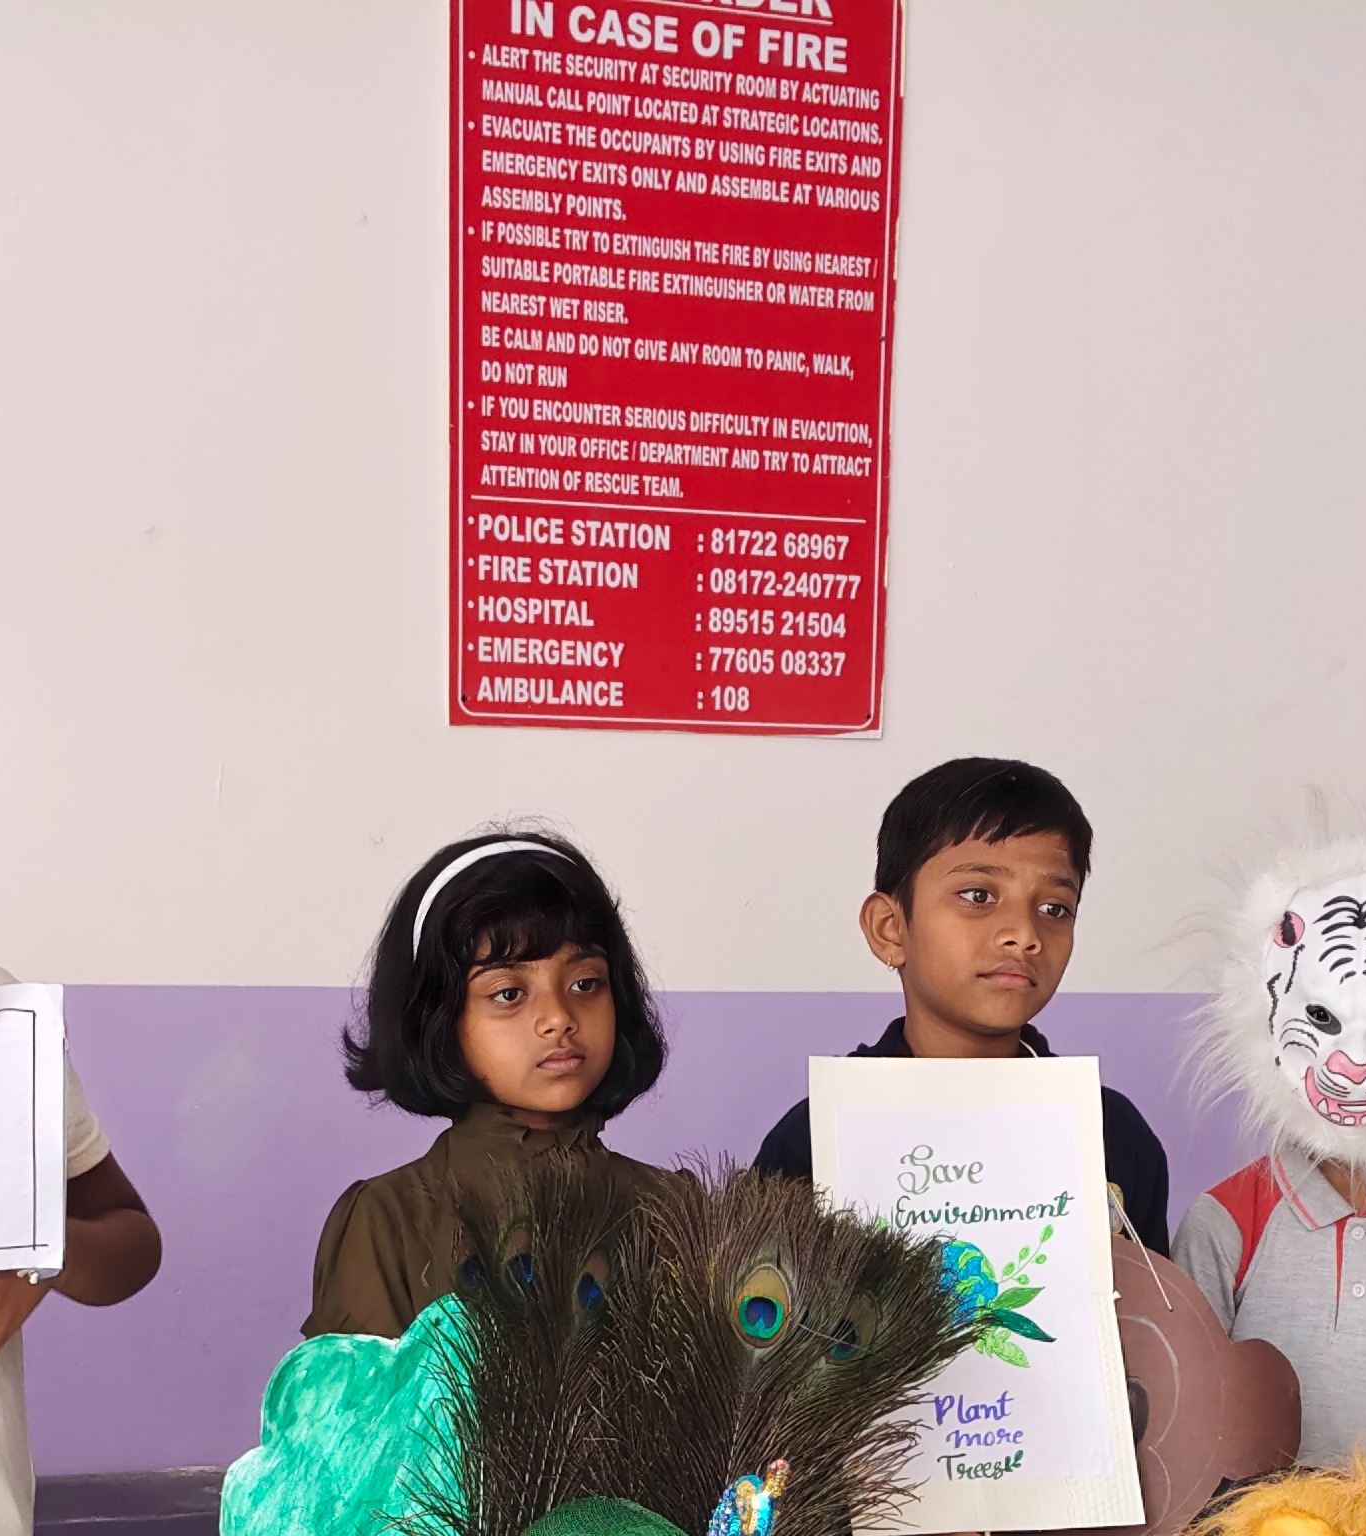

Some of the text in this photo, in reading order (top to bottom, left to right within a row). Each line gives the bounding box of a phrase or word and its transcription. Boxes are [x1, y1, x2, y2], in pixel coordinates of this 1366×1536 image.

[510, 1, 553, 38] IN
[568, 5, 678, 53] CASE
[692, 19, 745, 61] OF
[758, 28, 847, 73] FIRE
[482, 43, 879, 110] ALERT THE SECURITY AT SECURITY ROOM BY ACTUATING
[482, 79, 883, 145] MANUAL CALL POINT LOCATED AT STRATEGIC LOCATIONS.
[482, 114, 881, 178] EVACUATE THE OCCUPANTS BY USING FIRE EXITS AND
[482, 149, 879, 212] EMERGENCY EXITS ONLY AND ASSEMBLE AT VARIOUS
[481, 185, 626, 221] ASSEMBLY POINTS.
[481, 220, 494, 242] IF
[497, 221, 560, 249] POSSIBLE
[563, 228, 589, 251] TRY
[592, 231, 609, 253] TO
[612, 233, 691, 261] EXTINGUISH
[693, 241, 719, 264] THE
[721, 243, 750, 267] FIRE
[752, 246, 770, 268] BY
[773, 249, 811, 273] USING
[814, 252, 871, 278] NEAREST
[481, 255, 874, 311] SUITABLE PORTABLE FIRE EXTINGUISHER OR WATER FROM
[481, 290, 628, 324] NEAREST WET RISER.
[481, 325, 853, 379] BE CALM AND DO NOT GIVE ANY ROOM TO PANIC, WALK,
[481, 359, 567, 388] DO NOT RUN
[481, 395, 872, 447] IF YOU ENCOUNTER SERIOUS DIFFICULTY IN EVACUTION,
[480, 430, 515, 453] STAY
[519, 432, 534, 454] IN
[538, 434, 577, 457] YOUR
[579, 437, 629, 461] OFFICE
[639, 441, 729, 468] DEPARTMENT
[730, 448, 759, 470] AND
[762, 450, 789, 471] TRY
[791, 452, 809, 473] TO
[812, 453, 871, 477] ATTRACT
[480, 464, 683, 498] ATTENTION OF RESCUE TEAM.
[478, 513, 563, 545] POLICE
[570, 519, 670, 551] STATION
[478, 554, 531, 583] FIRE
[538, 558, 638, 589] STATION
[478, 595, 594, 626] HOSPITAL
[478, 636, 624, 667] EMERGENCY
[478, 677, 623, 706] AMBULANCE
[897, 1144, 984, 1195] Save
[894, 1190, 1076, 1230] Environment
[935, 1390, 1015, 1426] Plant
[946, 1428, 1024, 1449] more
[937, 1453, 1004, 1481] Trees
